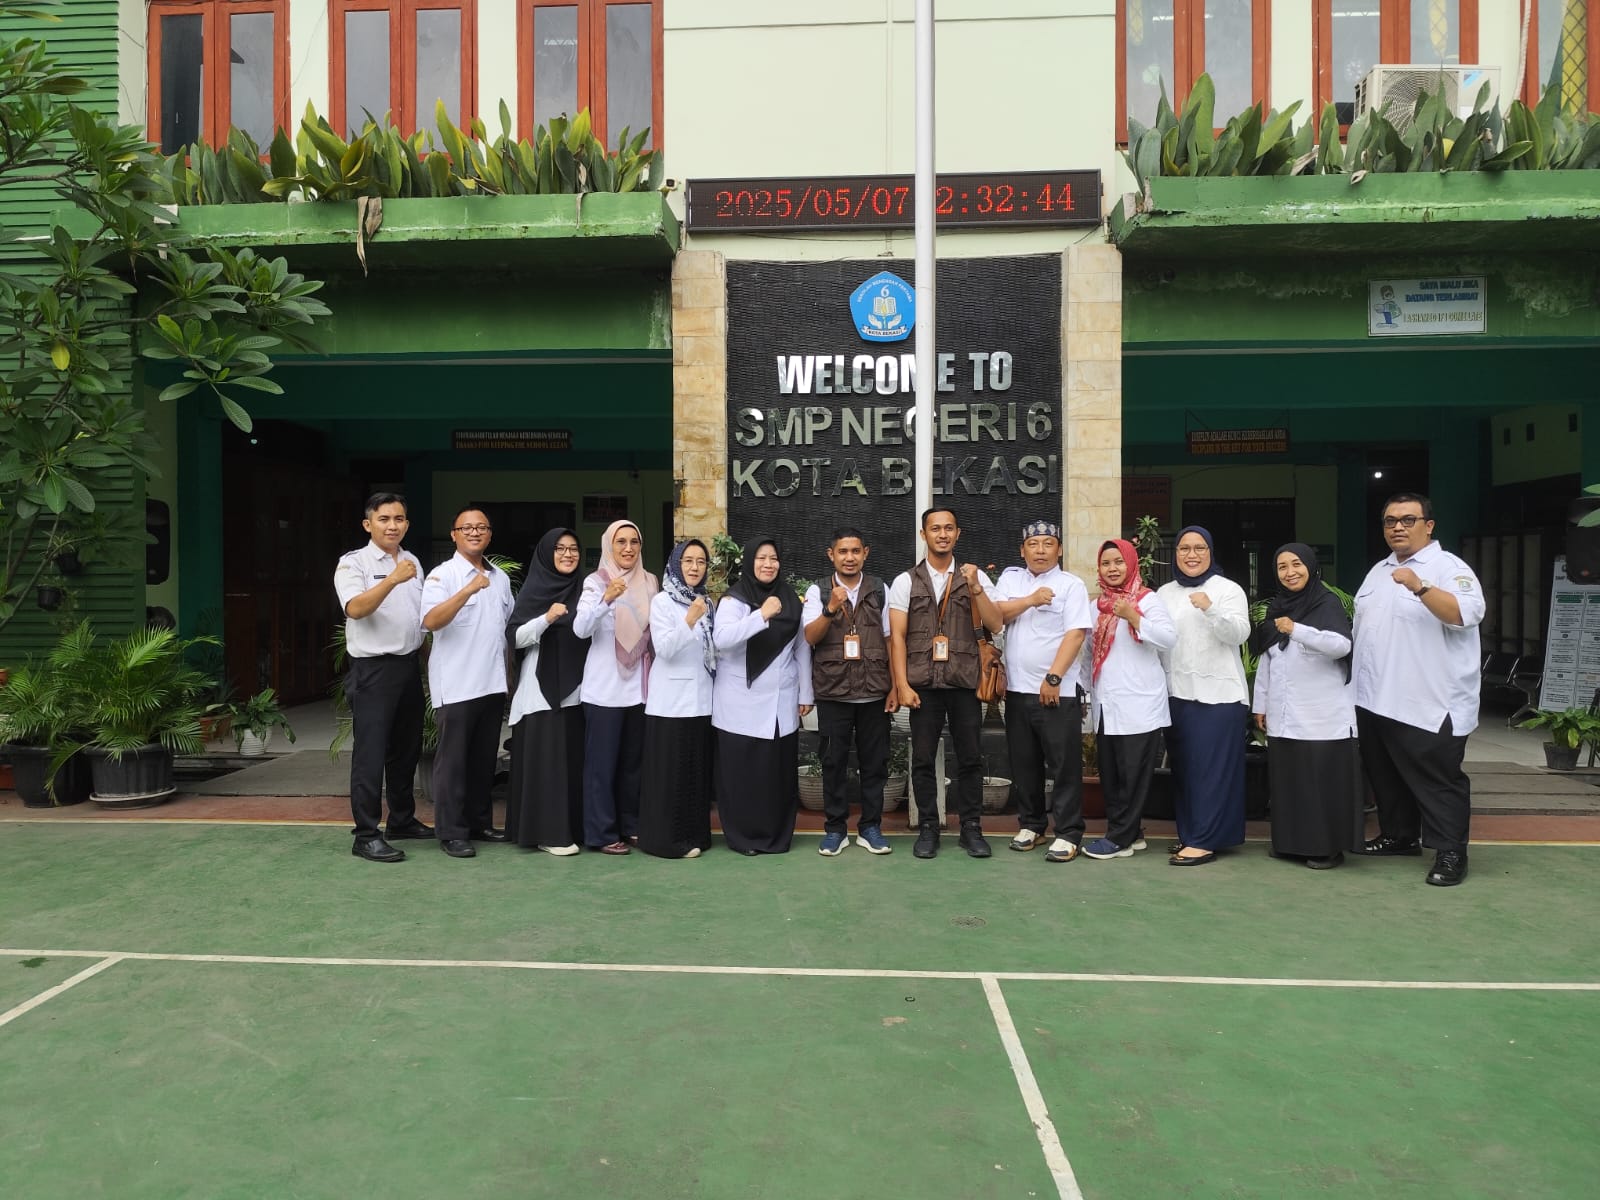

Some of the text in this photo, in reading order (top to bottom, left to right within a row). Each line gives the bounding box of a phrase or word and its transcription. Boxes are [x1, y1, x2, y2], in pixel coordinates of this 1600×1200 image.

[716, 184, 909, 219] 2025/05/07
[881, 284, 890, 297] 6
[968, 351, 1013, 391] TO
[735, 401, 1052, 446] SMP NEGERI 6
[733, 458, 868, 497] KOTA
